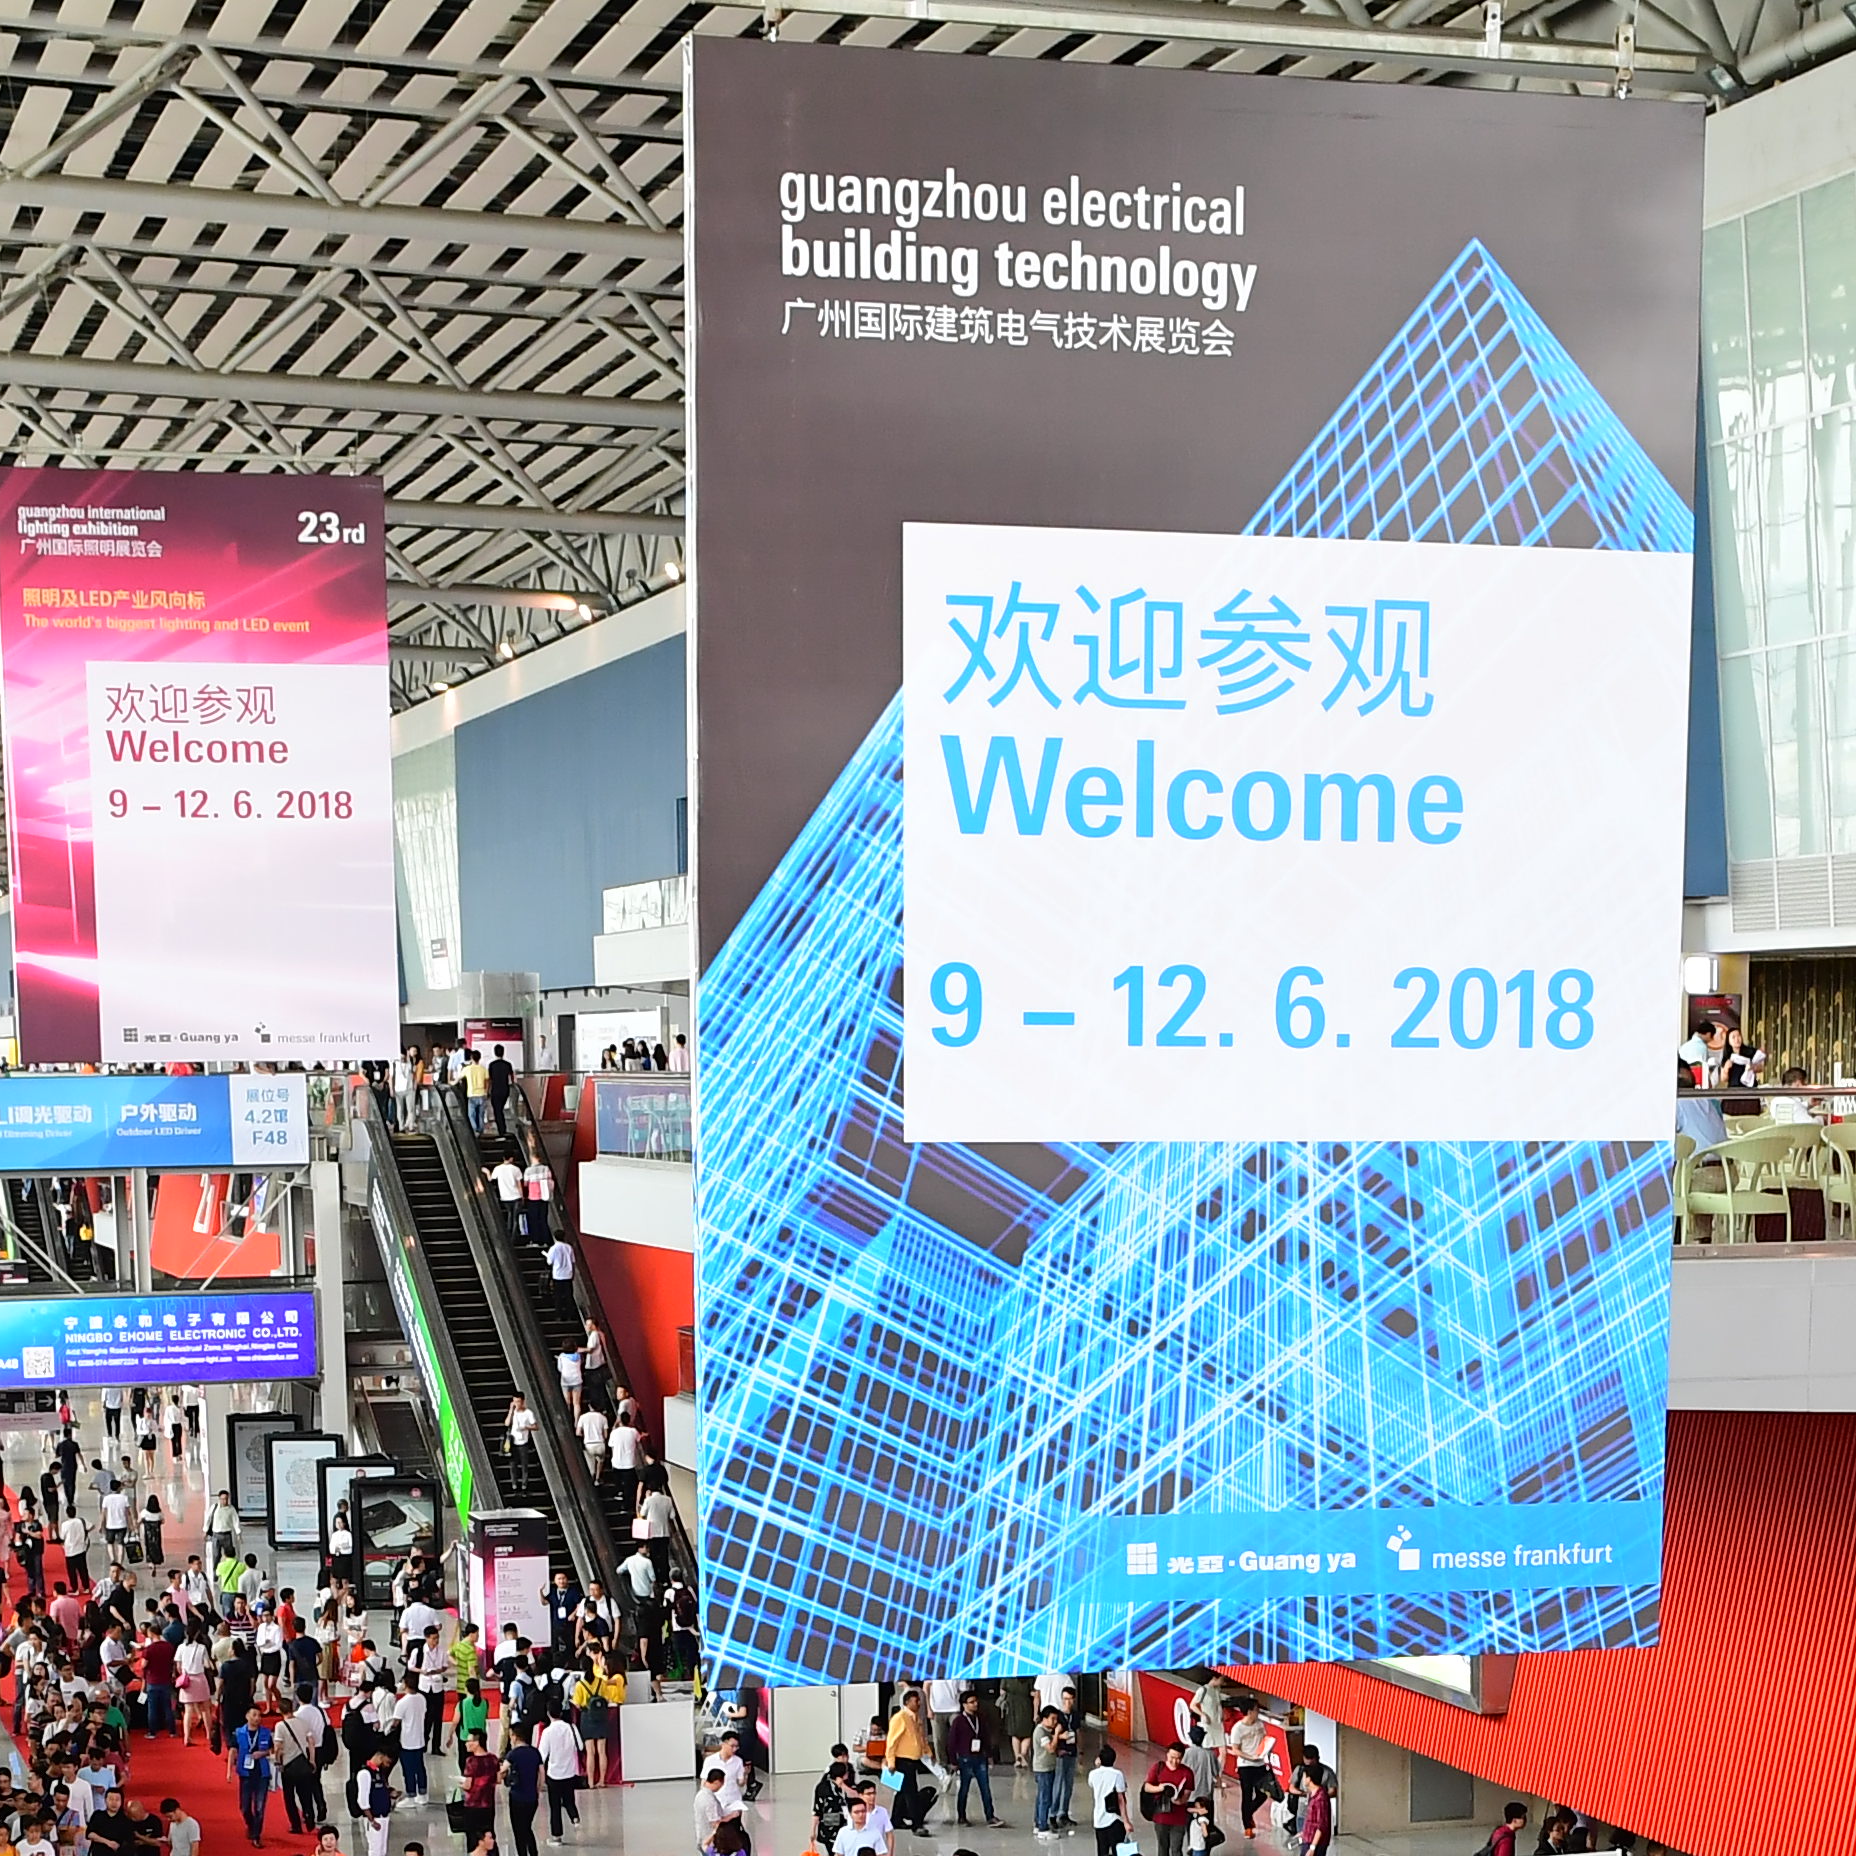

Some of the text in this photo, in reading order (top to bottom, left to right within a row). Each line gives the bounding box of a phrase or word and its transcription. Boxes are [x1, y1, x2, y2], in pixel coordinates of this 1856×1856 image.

[780, 168, 1245, 237] guangzhou electrical
[781, 223, 1257, 313] building technology
[782, 297, 1235, 358] 广州国际建筑电气技术展览会
[18, 505, 166, 527] guangzhou international
[18, 520, 139, 538] lighting exhibition
[297, 510, 366, 545] 23rd
[20, 537, 164, 559] 广州国际照明展览会
[22, 588, 206, 610] 照明及LED产业风向标
[24, 612, 311, 634] The world's biggest lighting and LED event
[941, 579, 1436, 720] 欢迎参观
[105, 681, 277, 726] 欢迎参观
[105, 730, 290, 764] Welcome
[941, 733, 1465, 846] Welcome
[109, 789, 353, 819] 9 12. 6. 2018
[929, 961, 1595, 1051] 9 12. 6. 2018
[224, 1032, 239, 1045] ya
[277, 1031, 371, 1044] messe frankfurt
[245, 1087, 290, 1103] 展位号
[119, 1102, 197, 1123] 户外驱动
[244, 1107, 289, 1125] 4.2馆
[2, 1129, 44, 1139] Dimming
[44, 1128, 72, 1138] Driver
[116, 1126, 201, 1136] Outdoor LED Driver
[252, 1129, 288, 1145] F48
[65, 1332, 113, 1344] NINGBO
[119, 1331, 163, 1343] EHOME
[170, 1329, 247, 1342] ELECTRONIC
[1239, 1550, 1357, 1574] Guang ya
[1432, 1543, 1614, 1570] messe frankfurt
